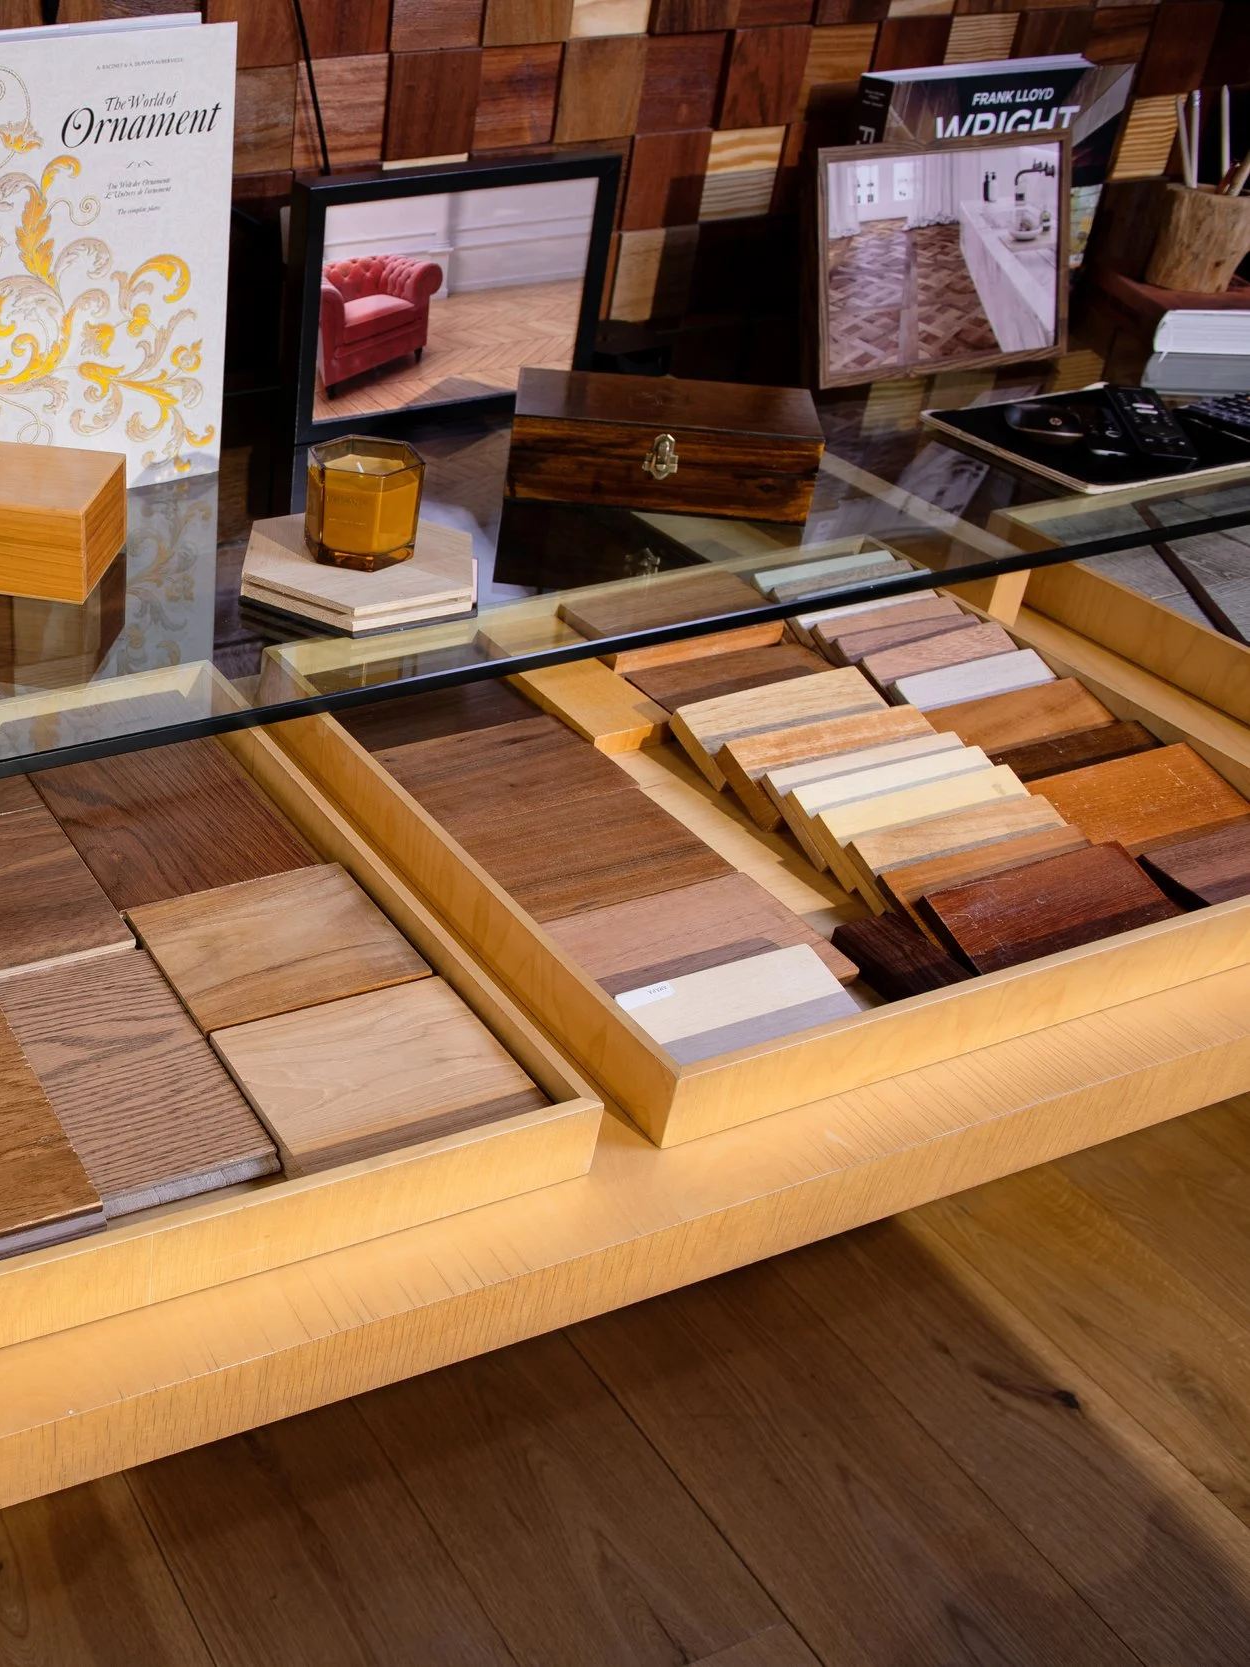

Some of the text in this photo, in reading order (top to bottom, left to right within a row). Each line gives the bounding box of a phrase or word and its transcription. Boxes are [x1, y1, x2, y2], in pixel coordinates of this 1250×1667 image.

[105, 90, 178, 112] The World of
[971, 87, 1054, 106] FRANK LLOYD
[61, 101, 222, 149] Ornament
